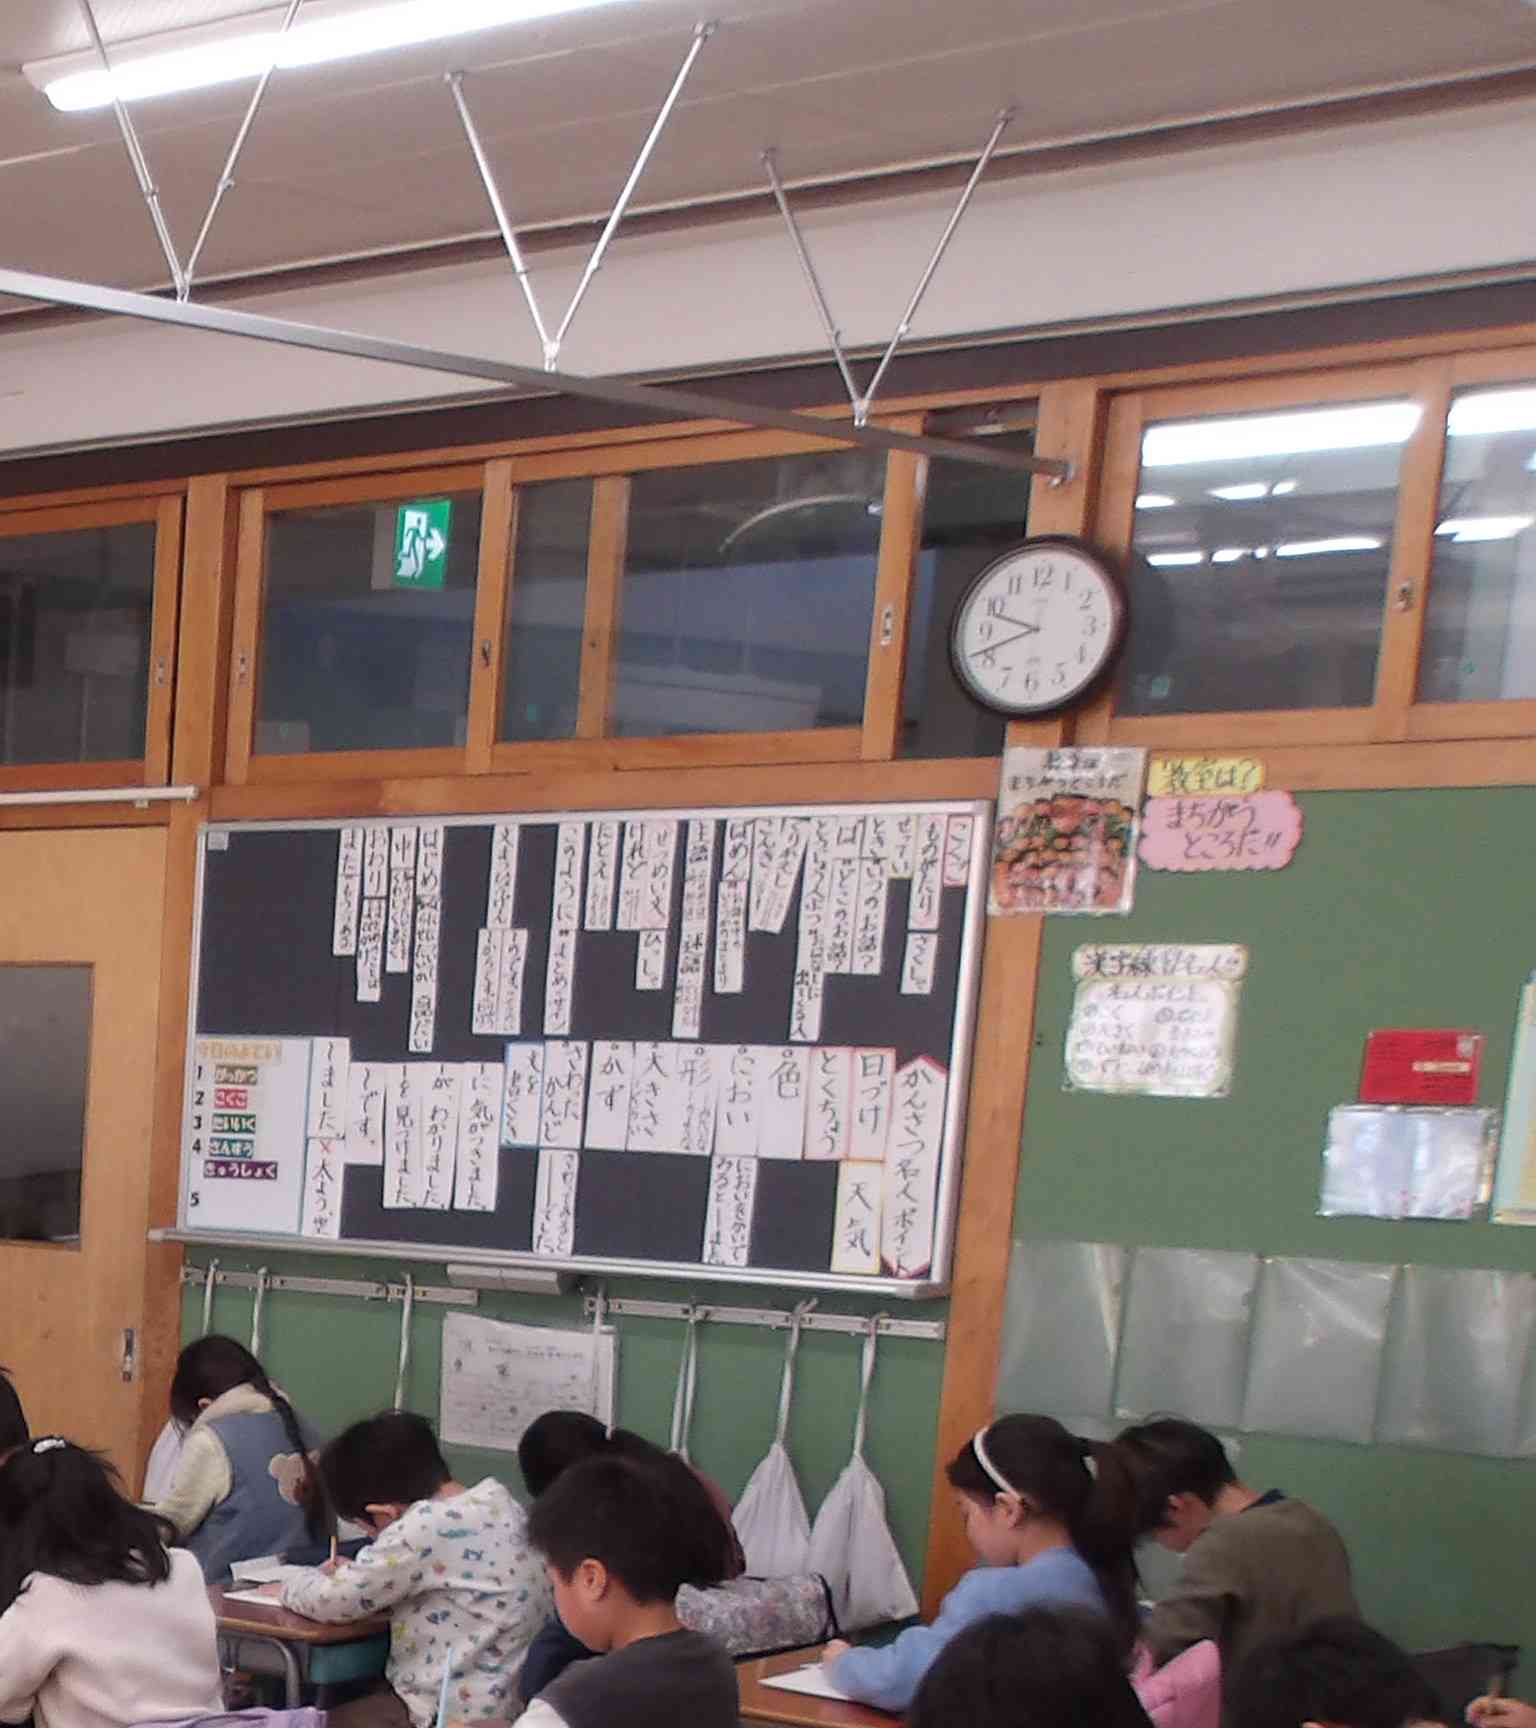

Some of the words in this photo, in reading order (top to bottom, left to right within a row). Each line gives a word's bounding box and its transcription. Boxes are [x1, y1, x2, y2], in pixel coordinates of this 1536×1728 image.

[596, 1056, 625, 1113] かず
[769, 1060, 800, 1098] 色
[858, 1054, 888, 1136] 日づけ
